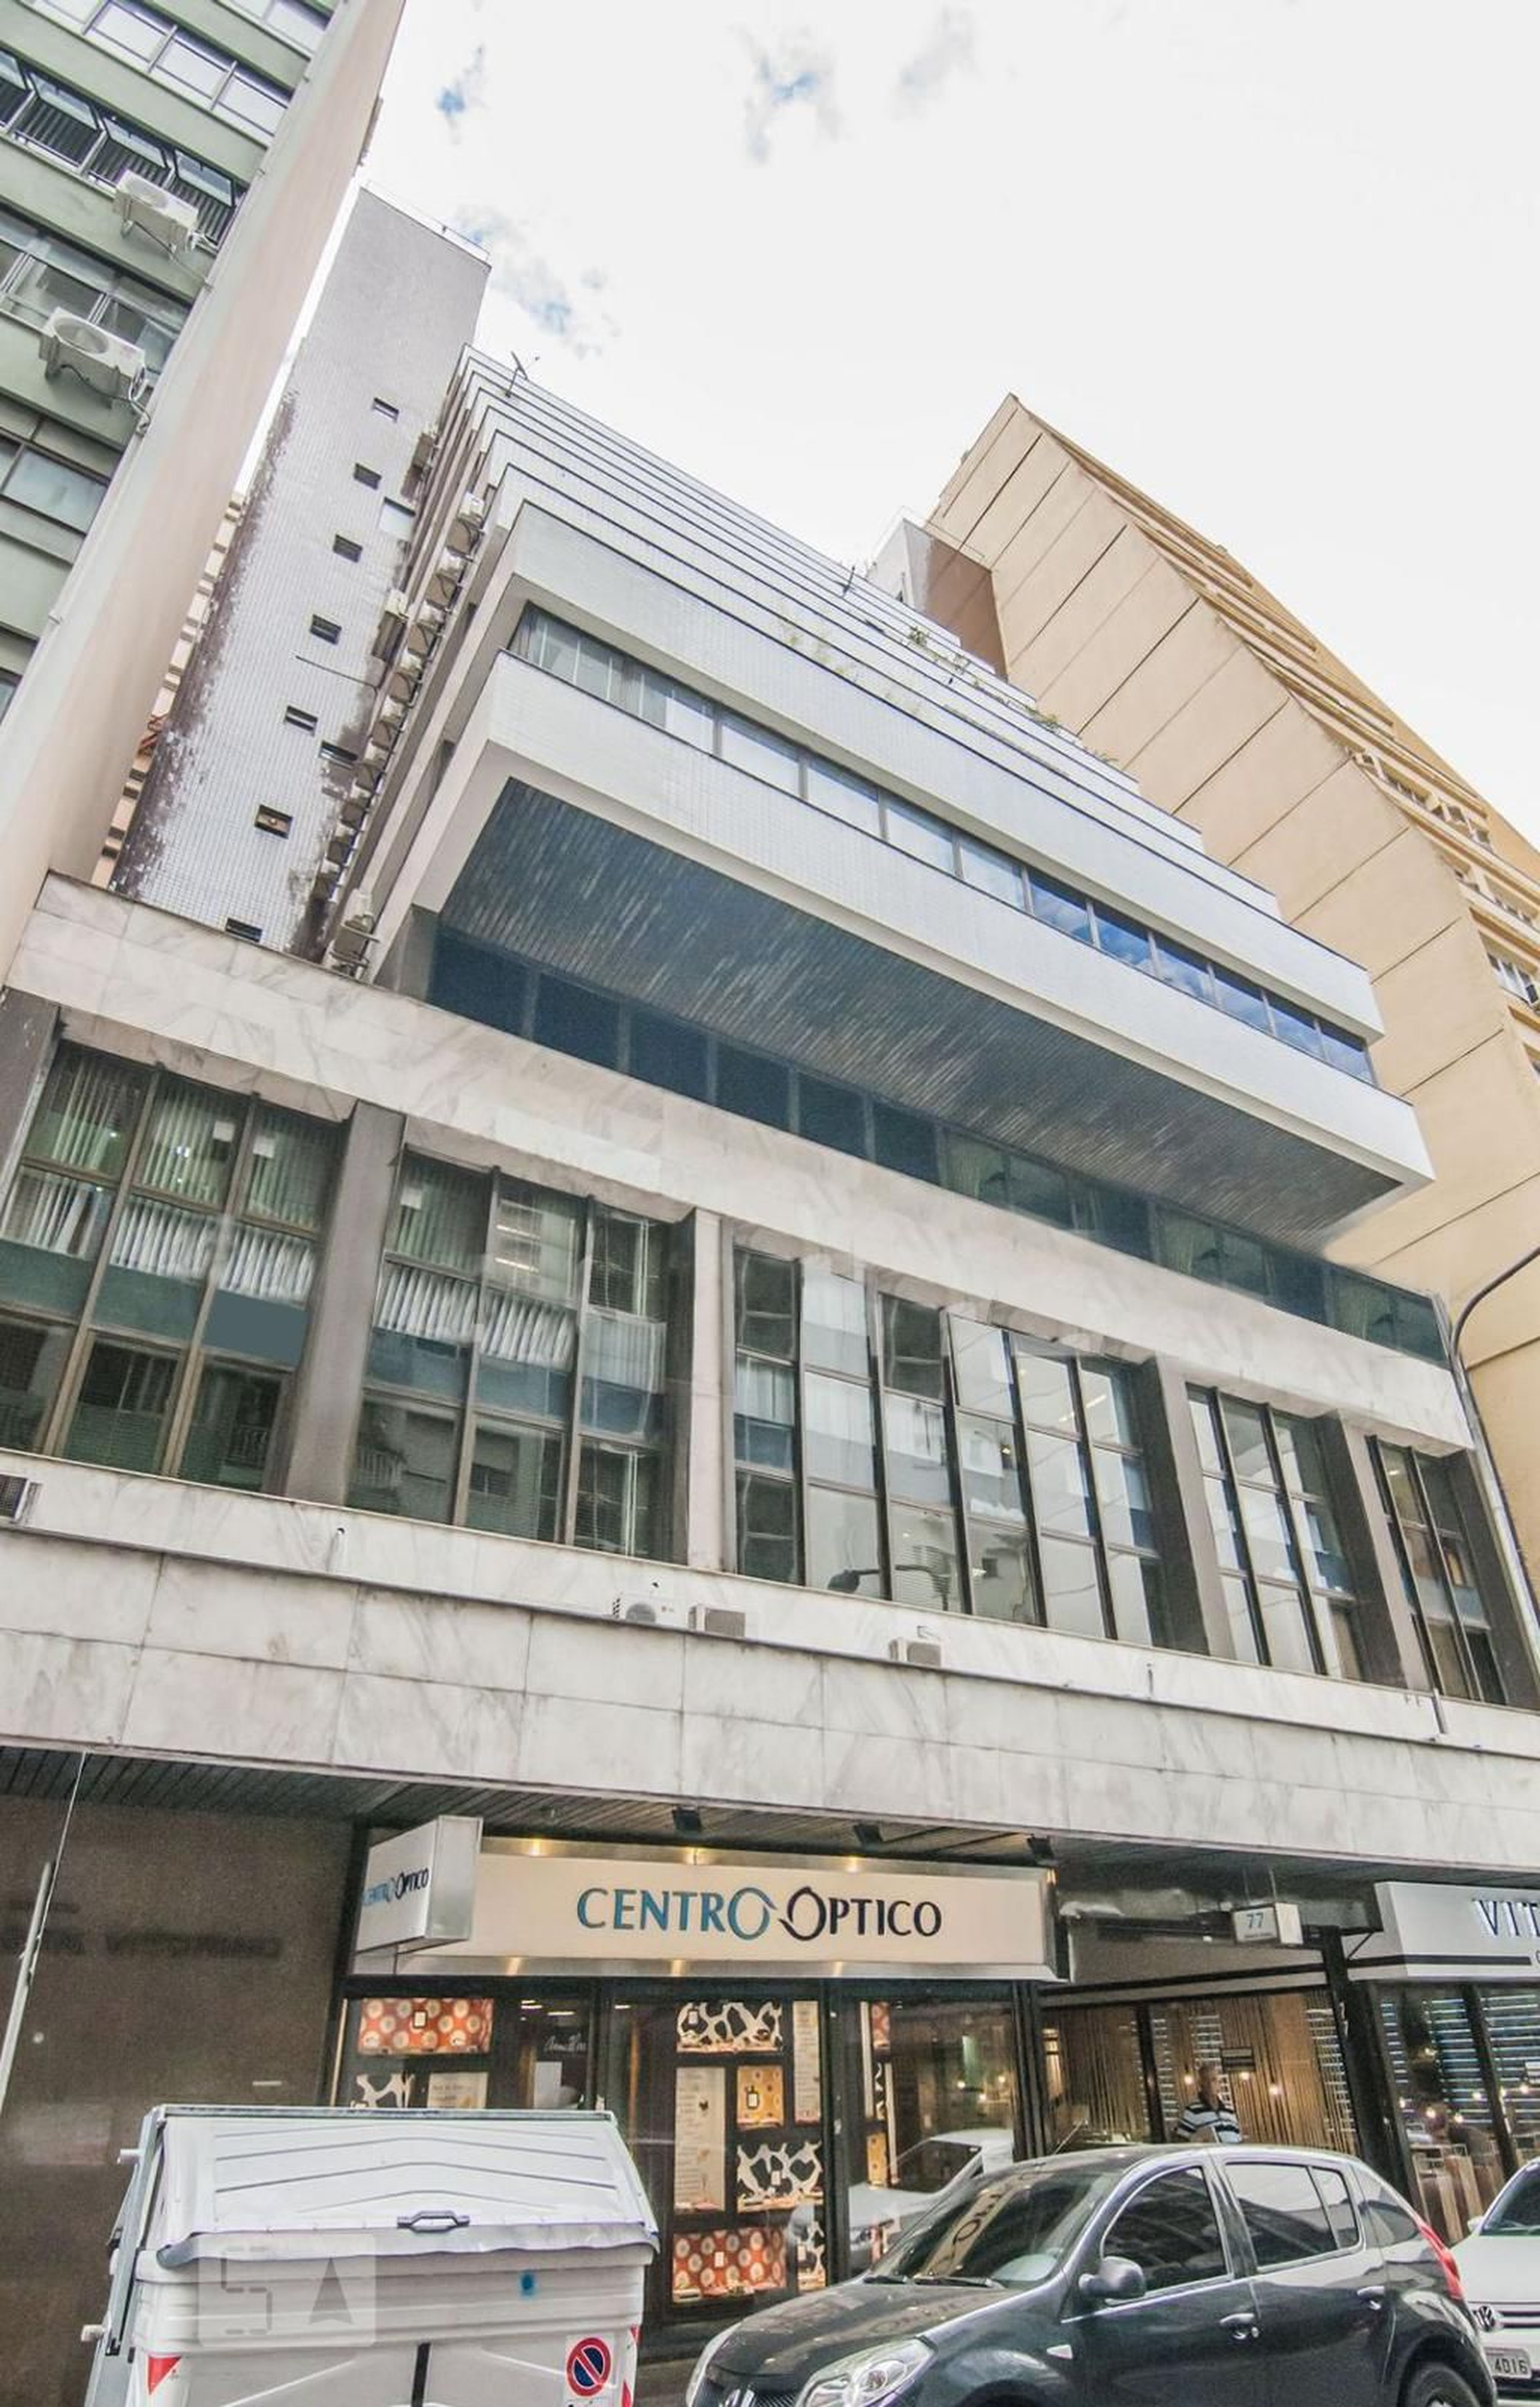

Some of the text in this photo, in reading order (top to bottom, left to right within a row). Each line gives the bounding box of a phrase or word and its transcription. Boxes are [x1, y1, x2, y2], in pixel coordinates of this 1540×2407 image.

[576, 1886, 777, 1941] CENTRO
[1246, 1911, 1263, 1928] 77
[1495, 2358, 1528, 2375] 4016
